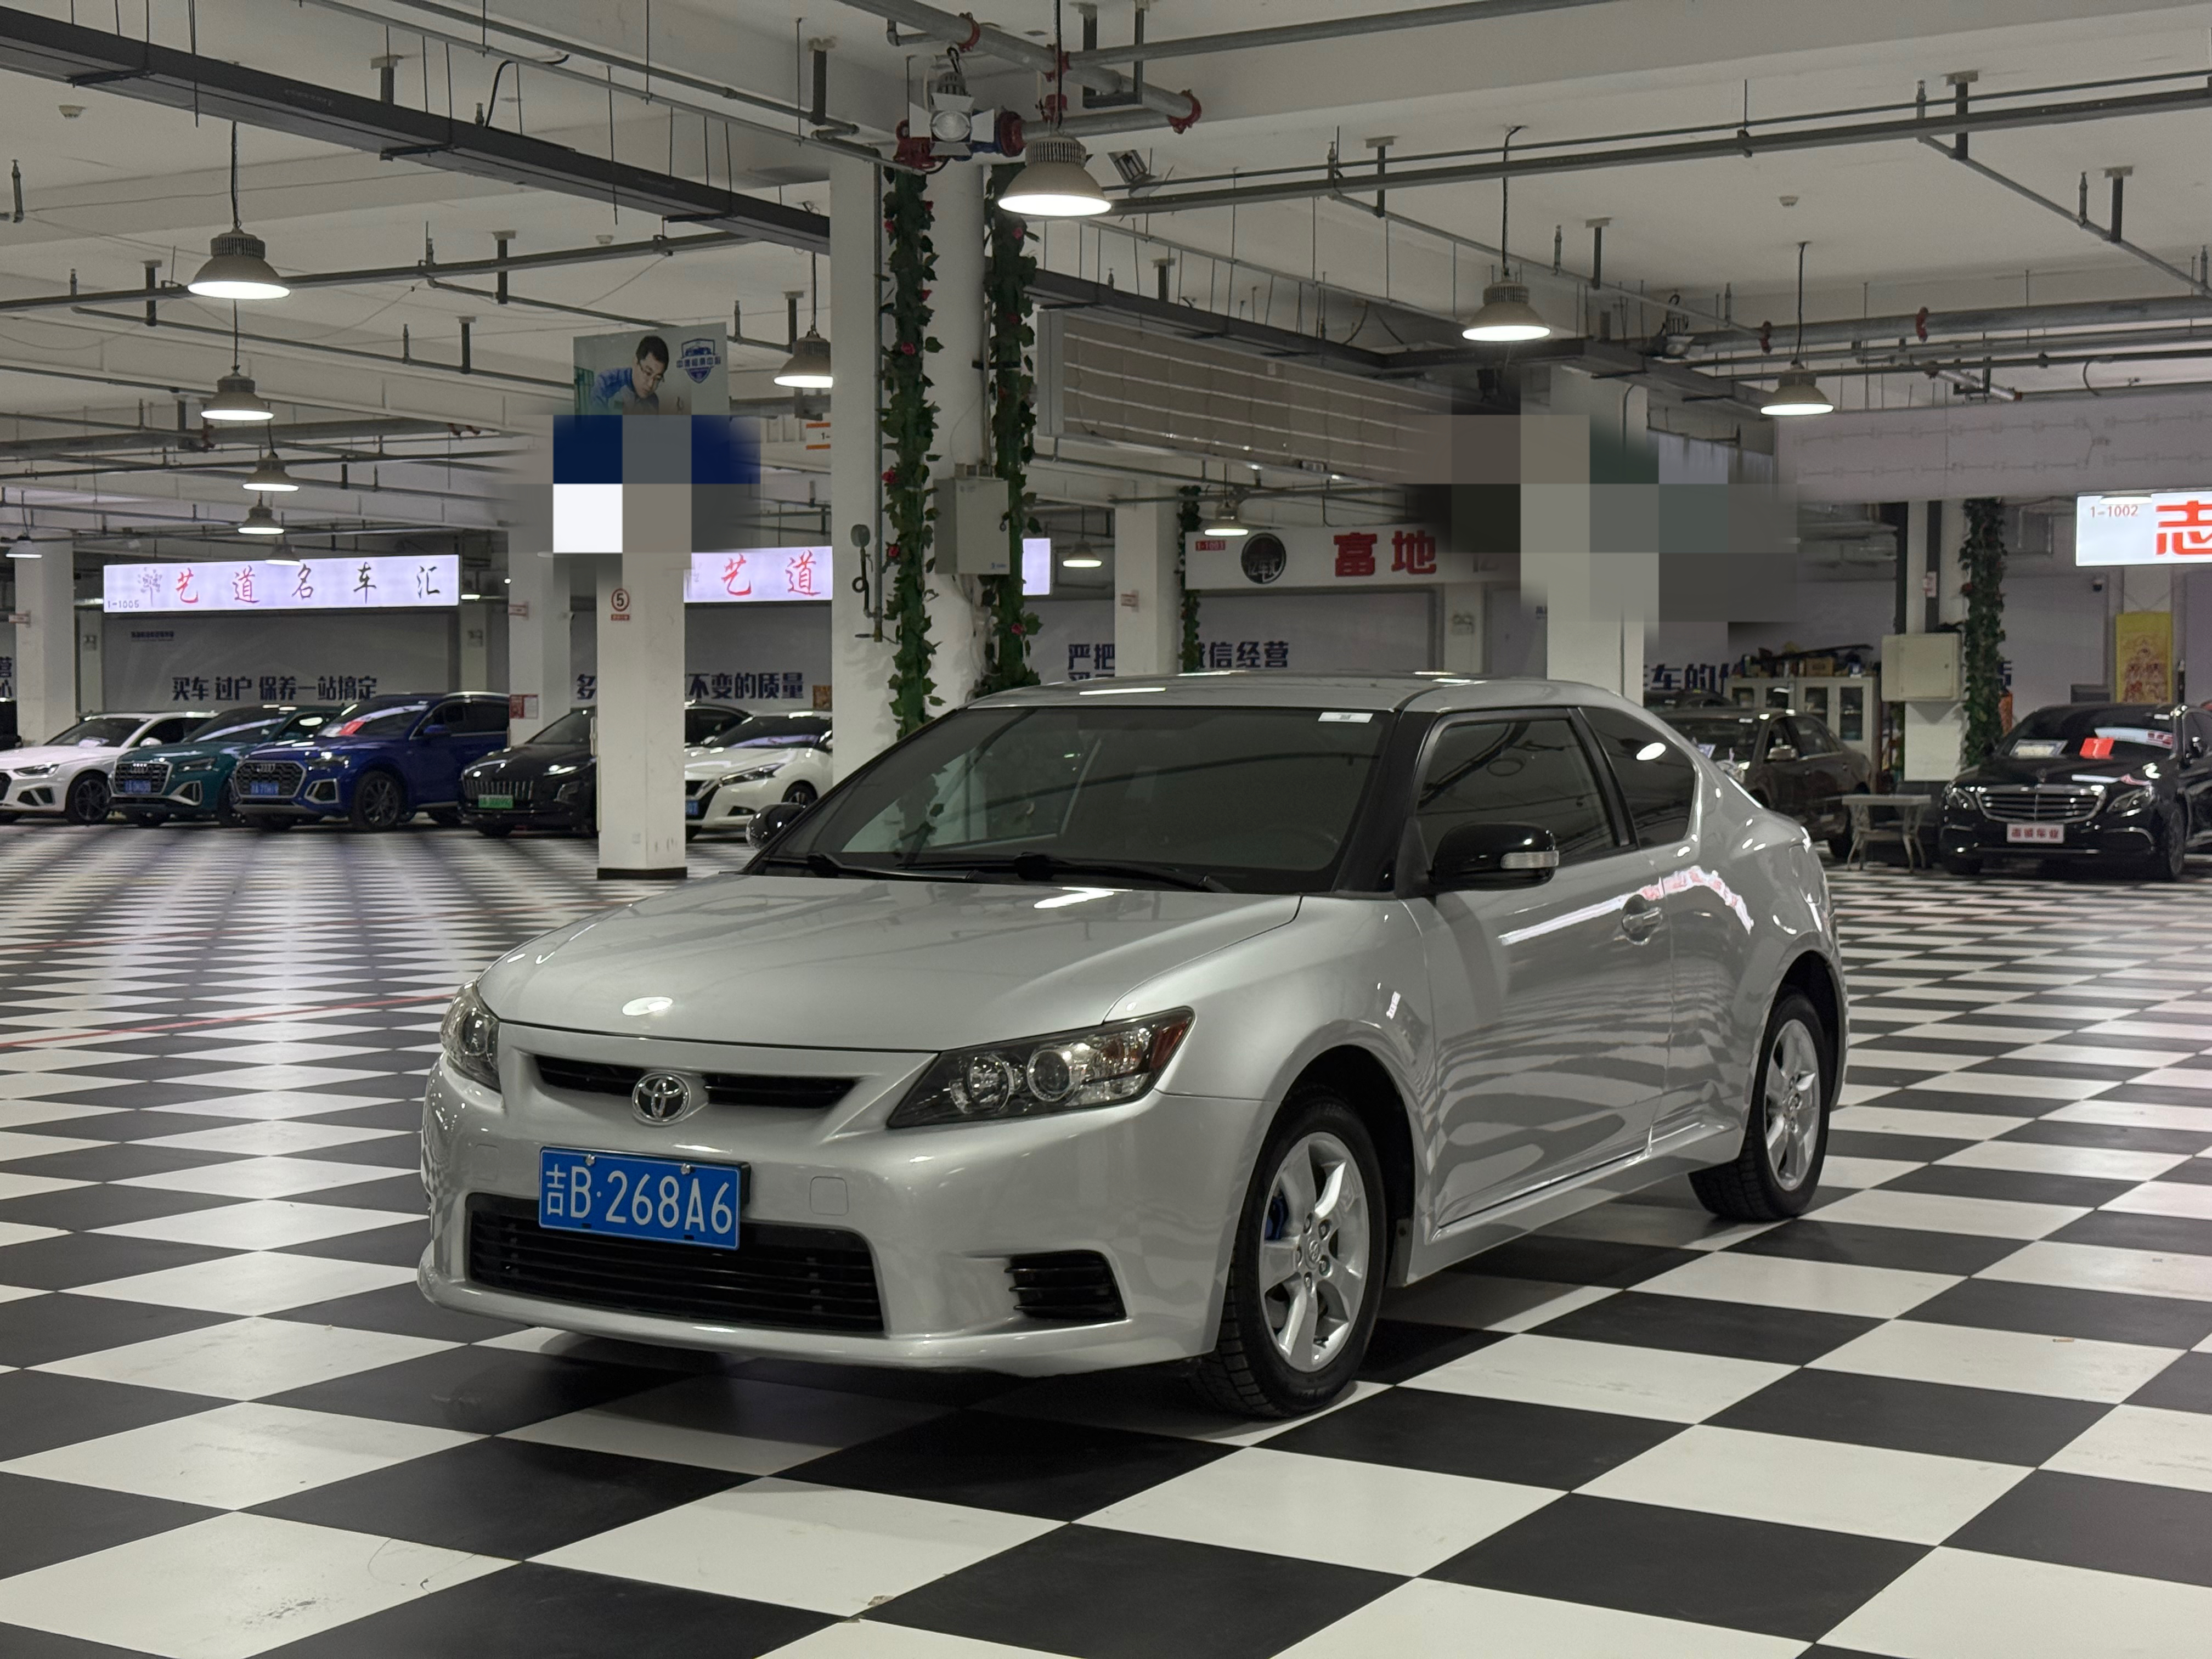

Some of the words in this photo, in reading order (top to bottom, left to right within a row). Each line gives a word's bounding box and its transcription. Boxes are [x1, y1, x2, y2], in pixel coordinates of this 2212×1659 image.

[2090, 505, 2138, 518] 1-1002
[1333, 530, 1437, 577] 富地
[176, 562, 440, 604] 艺道名车汇
[721, 550, 821, 596] 艺道
[108, 600, 139, 608] 1-1005
[617, 592, 624, 607] 5
[172, 676, 209, 701] 买车
[215, 676, 252, 701] 过户
[259, 675, 377, 701] 保养一站搞定
[688, 672, 804, 699] 不变的质量
